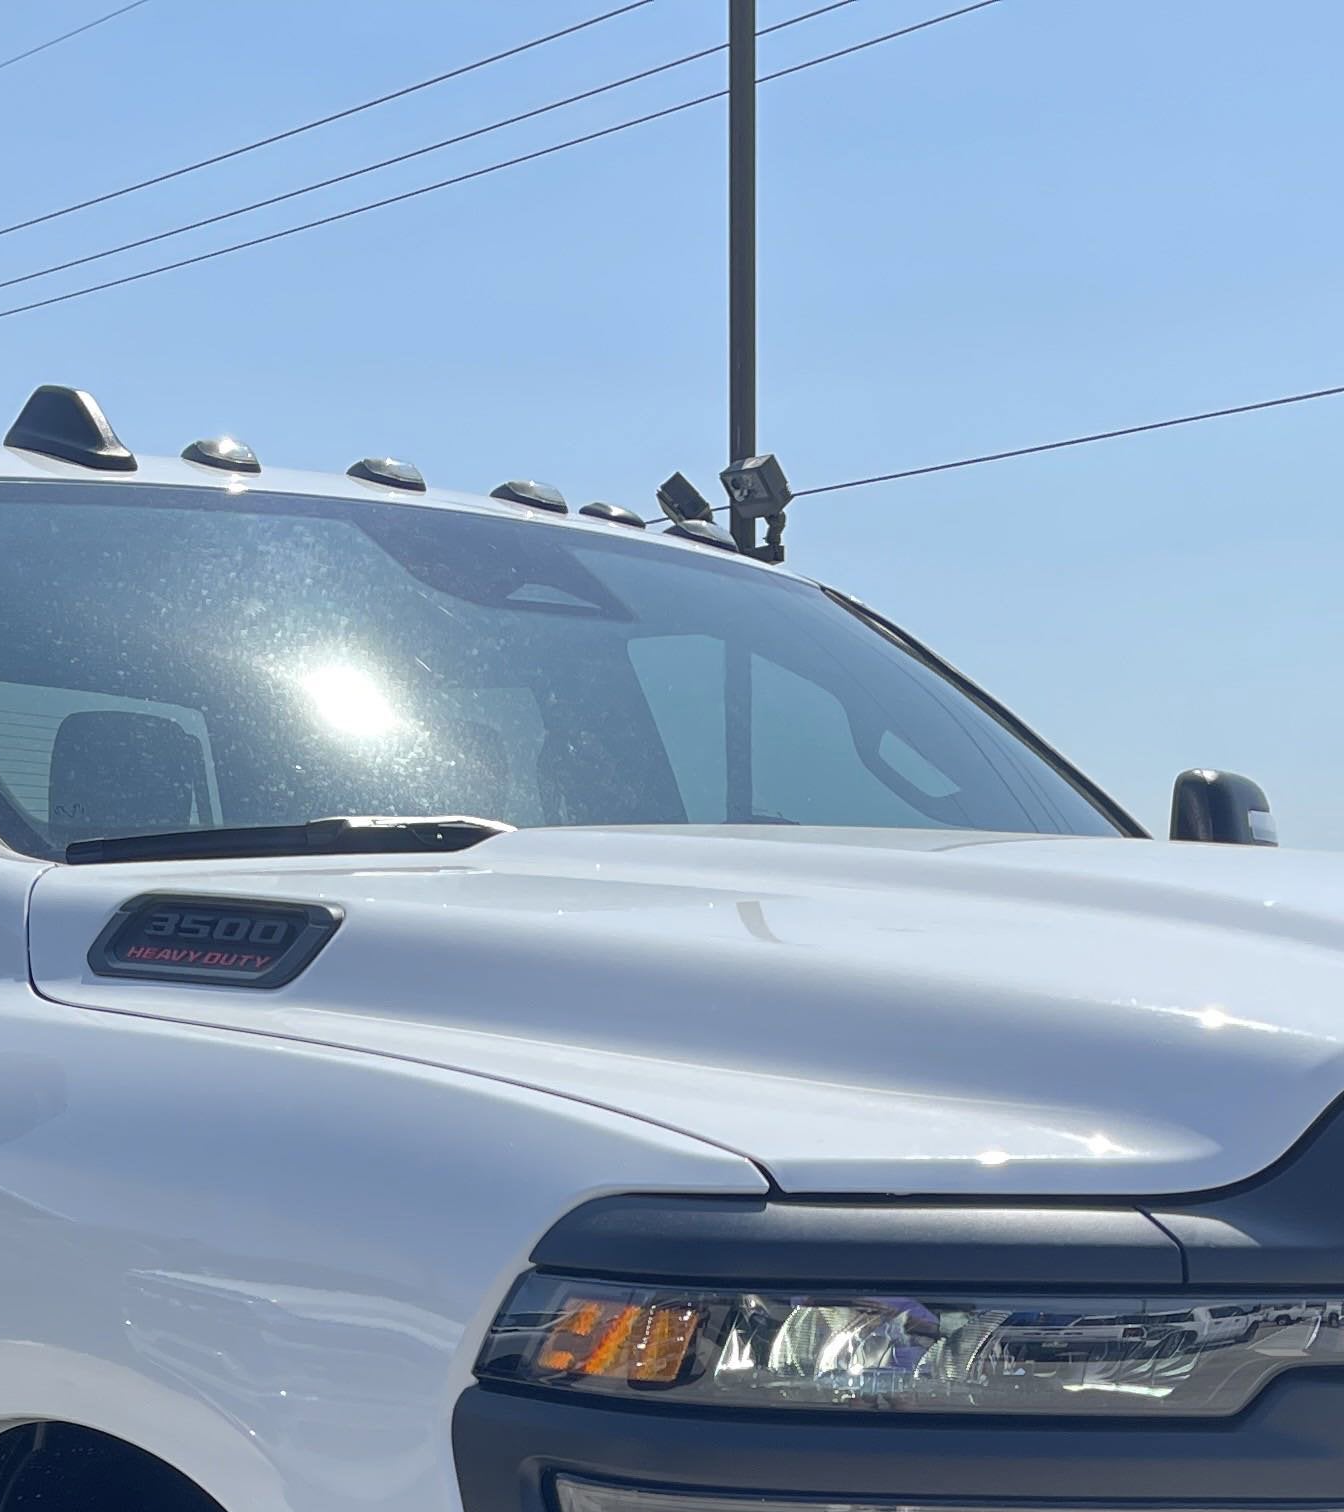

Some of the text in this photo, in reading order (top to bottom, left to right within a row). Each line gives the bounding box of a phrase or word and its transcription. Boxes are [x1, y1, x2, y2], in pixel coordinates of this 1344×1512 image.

[145, 913, 289, 944] 3500
[127, 946, 272, 968] HEAVY DUTY
